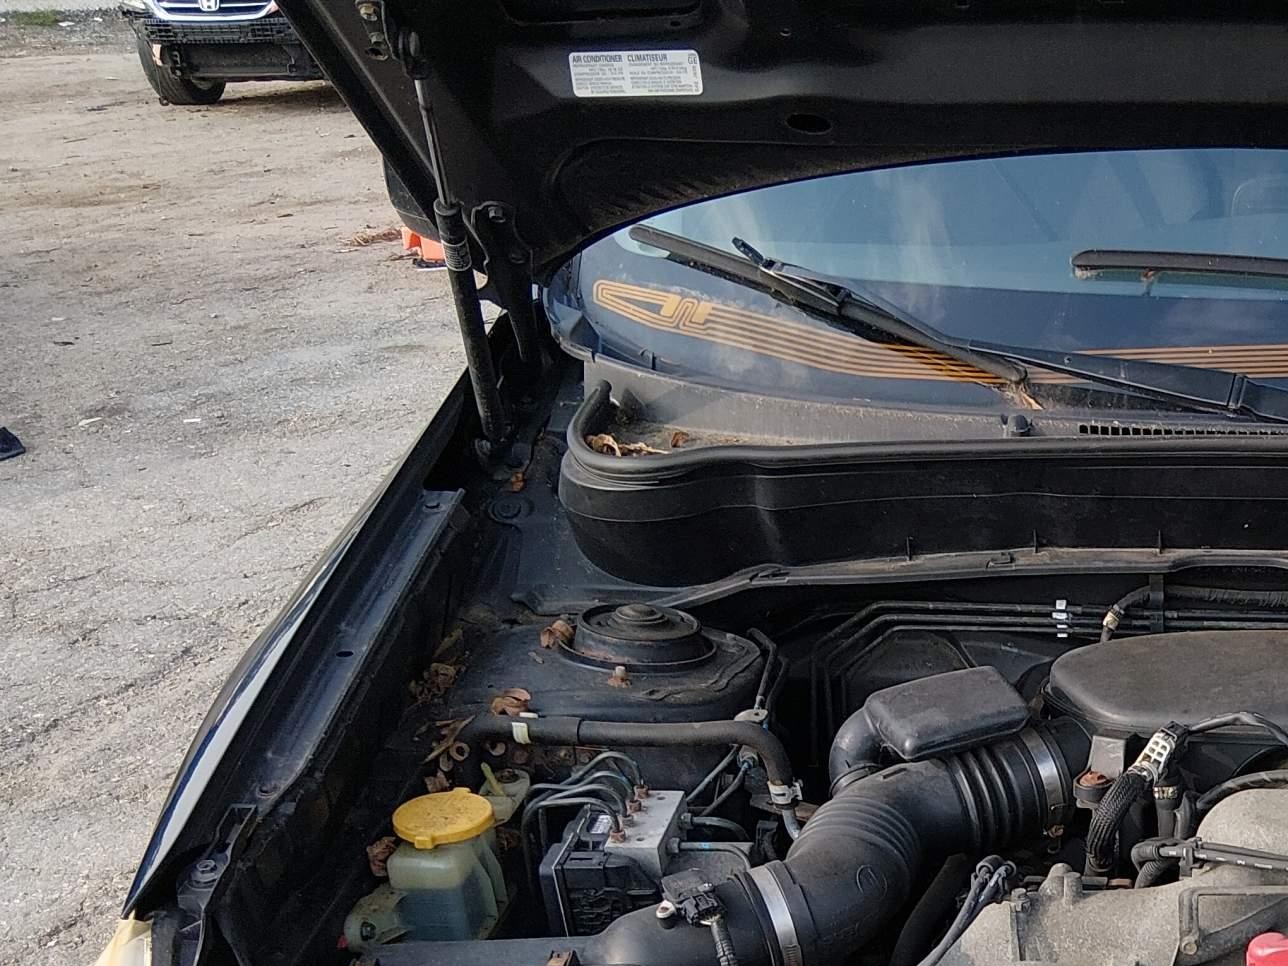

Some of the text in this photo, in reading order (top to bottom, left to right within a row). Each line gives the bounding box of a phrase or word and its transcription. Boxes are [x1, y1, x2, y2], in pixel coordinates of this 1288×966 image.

[572, 54, 623, 64] AIR CONDITIONER
[627, 53, 668, 62] CLIMATISEUR
